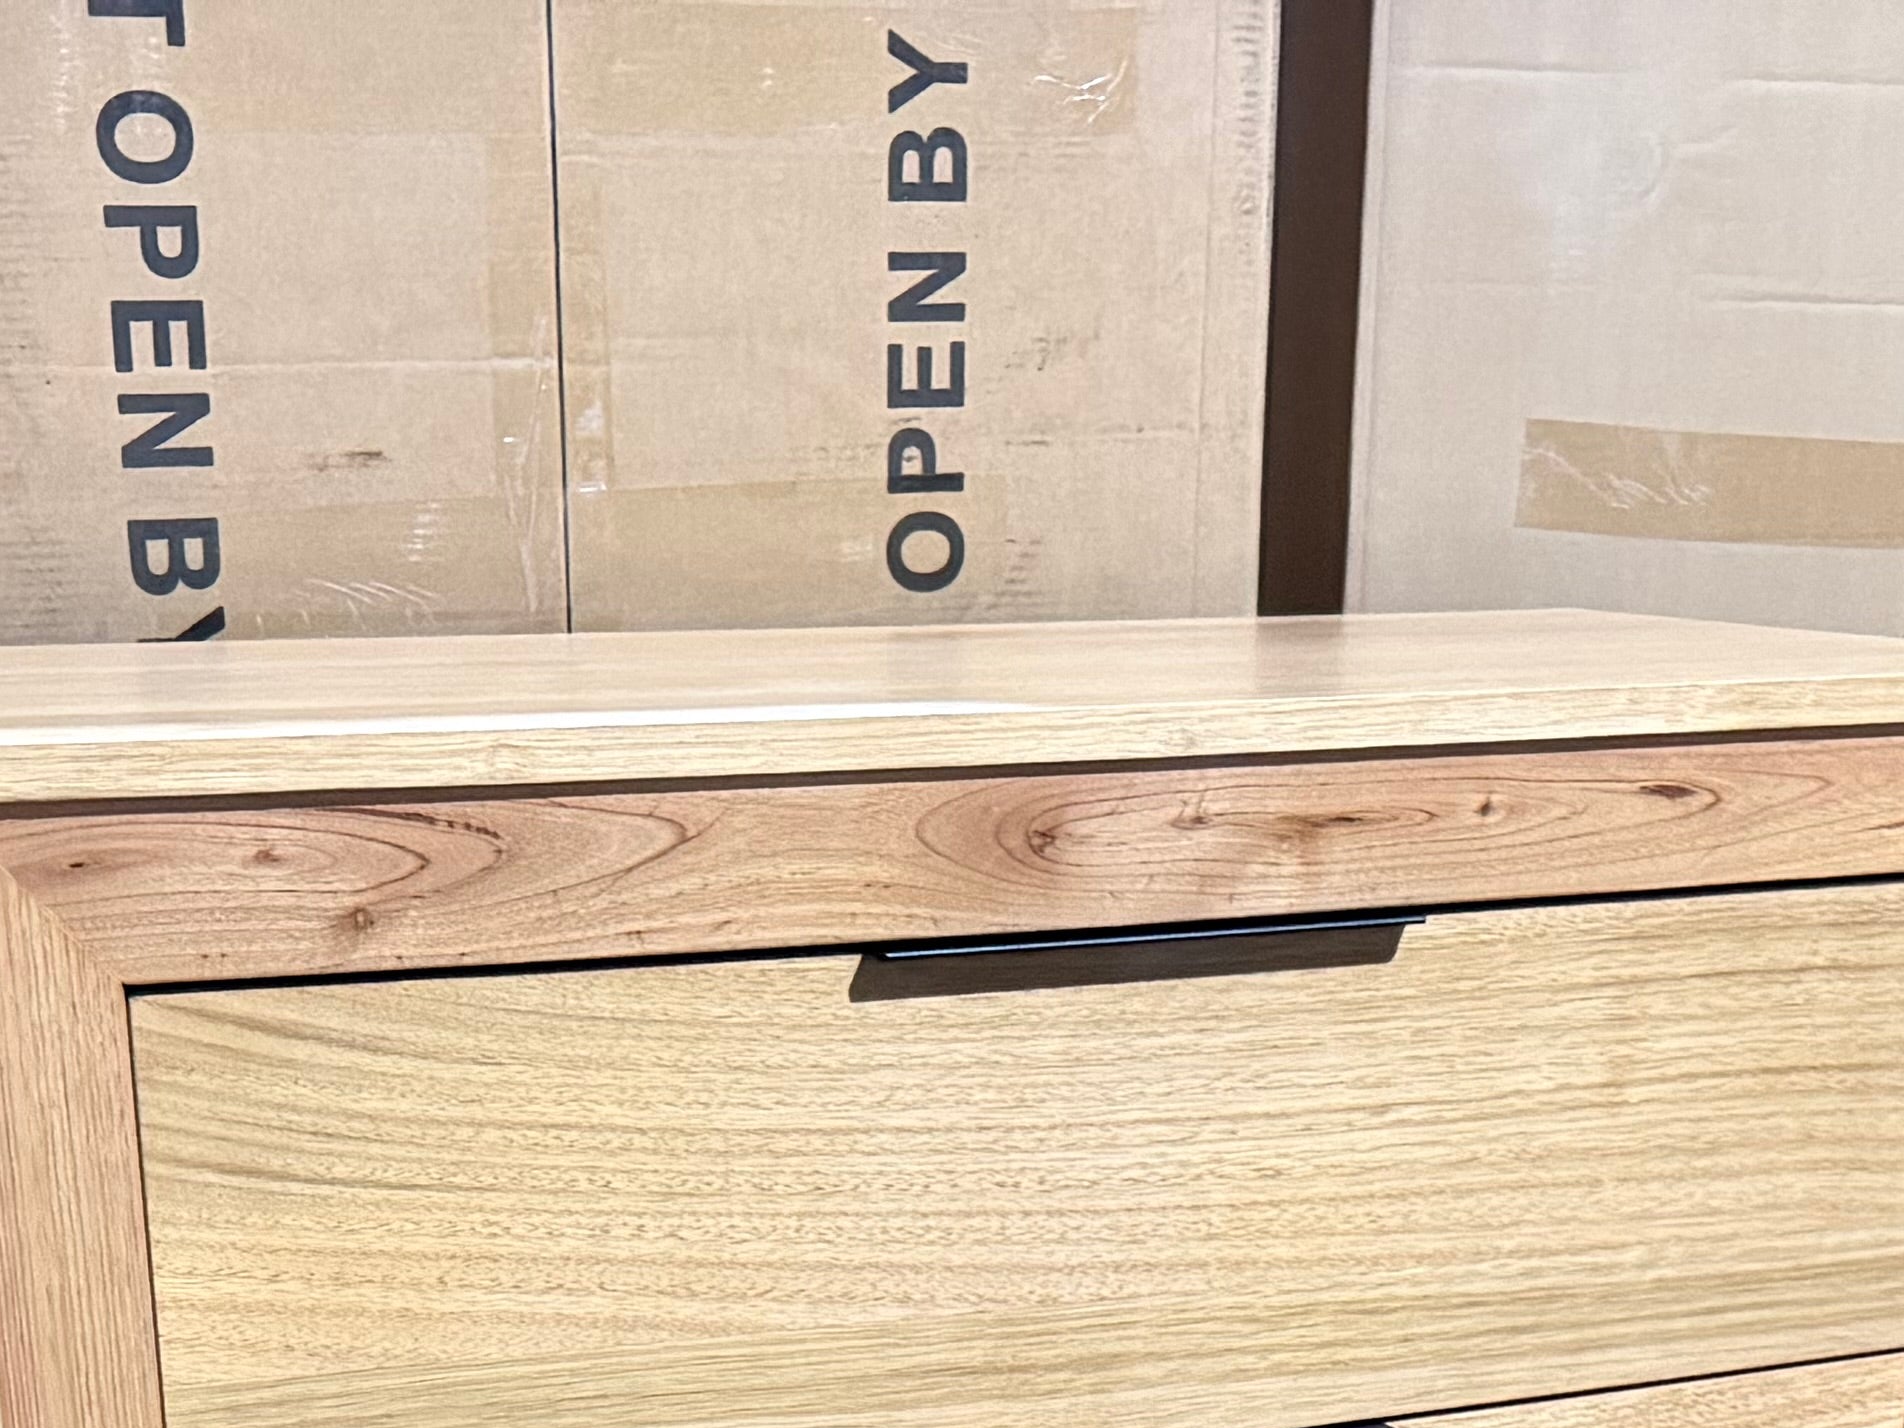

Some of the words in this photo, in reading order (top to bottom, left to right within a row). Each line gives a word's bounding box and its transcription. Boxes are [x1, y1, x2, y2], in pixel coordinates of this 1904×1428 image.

[96, 89, 214, 469] OPEN
[888, 29, 968, 203] BY
[886, 252, 967, 592] OPEN
